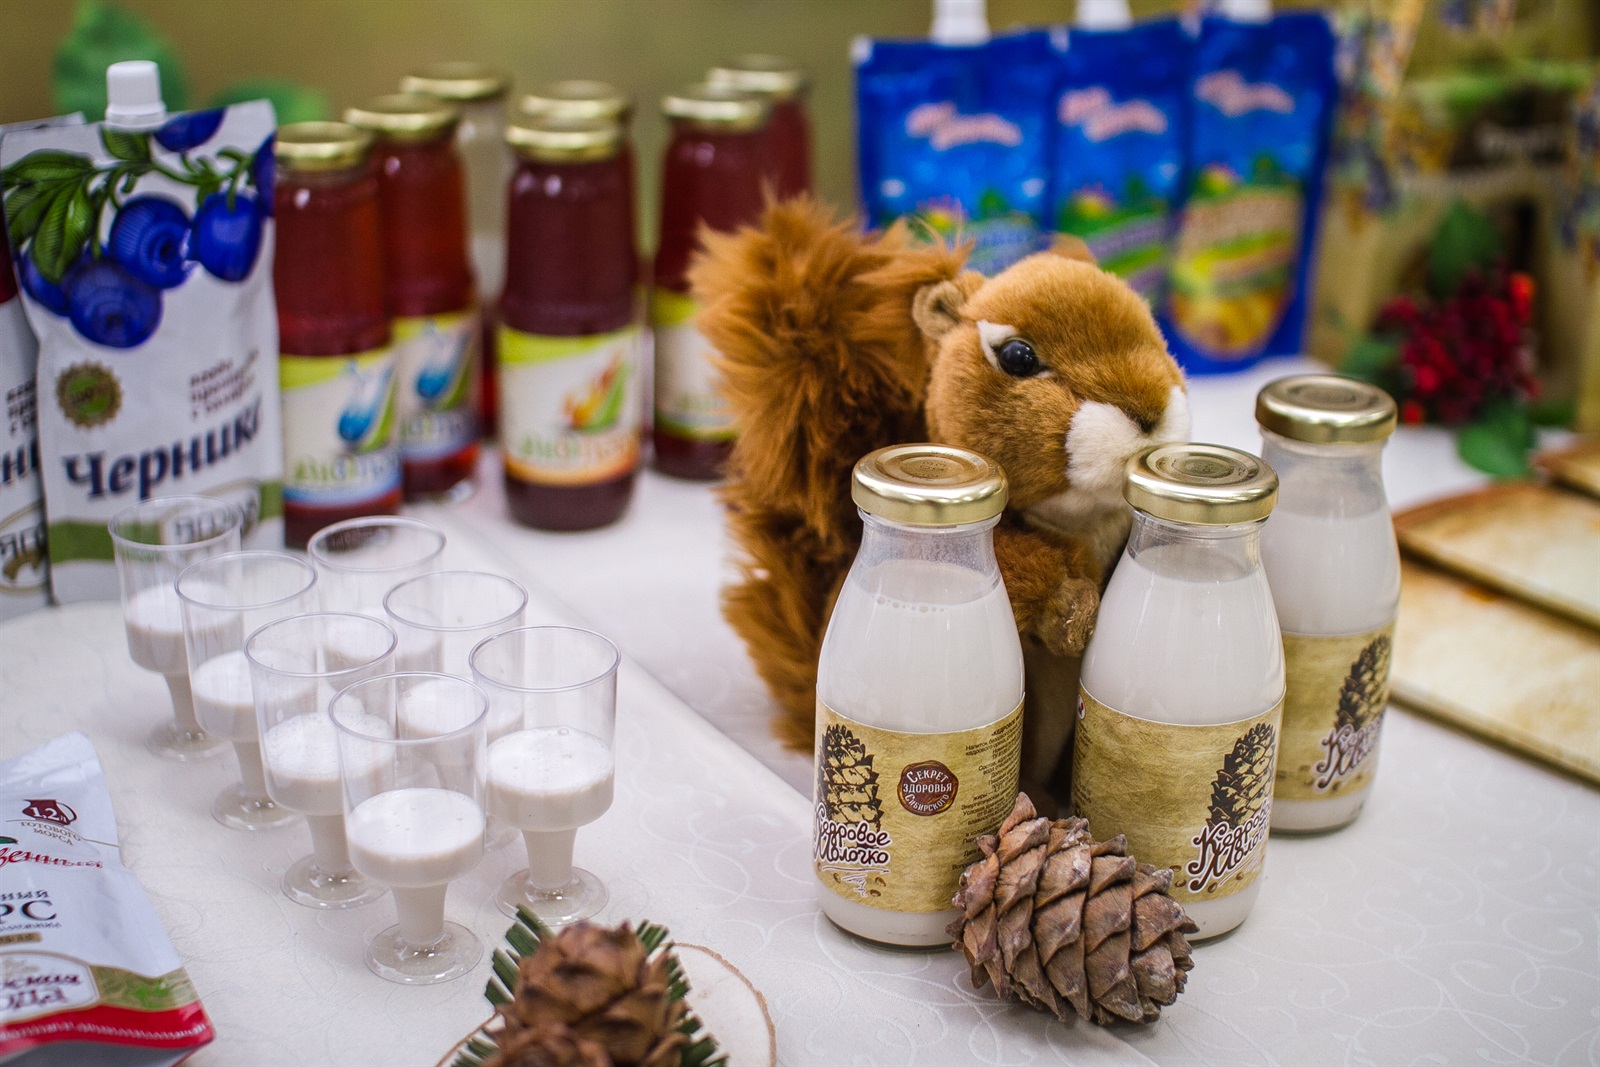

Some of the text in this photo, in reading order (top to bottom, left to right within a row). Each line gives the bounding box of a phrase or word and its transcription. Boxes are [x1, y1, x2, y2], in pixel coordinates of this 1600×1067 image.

[906, 769, 949, 783] СЕКРЕТ
[903, 782, 952, 793] ЗДОРОВЬЯ
[904, 793, 950, 812] СИБИРСКОГО
[20, 821, 81, 841] ГОТОВОГО
[33, 828, 74, 846] МОРСА
